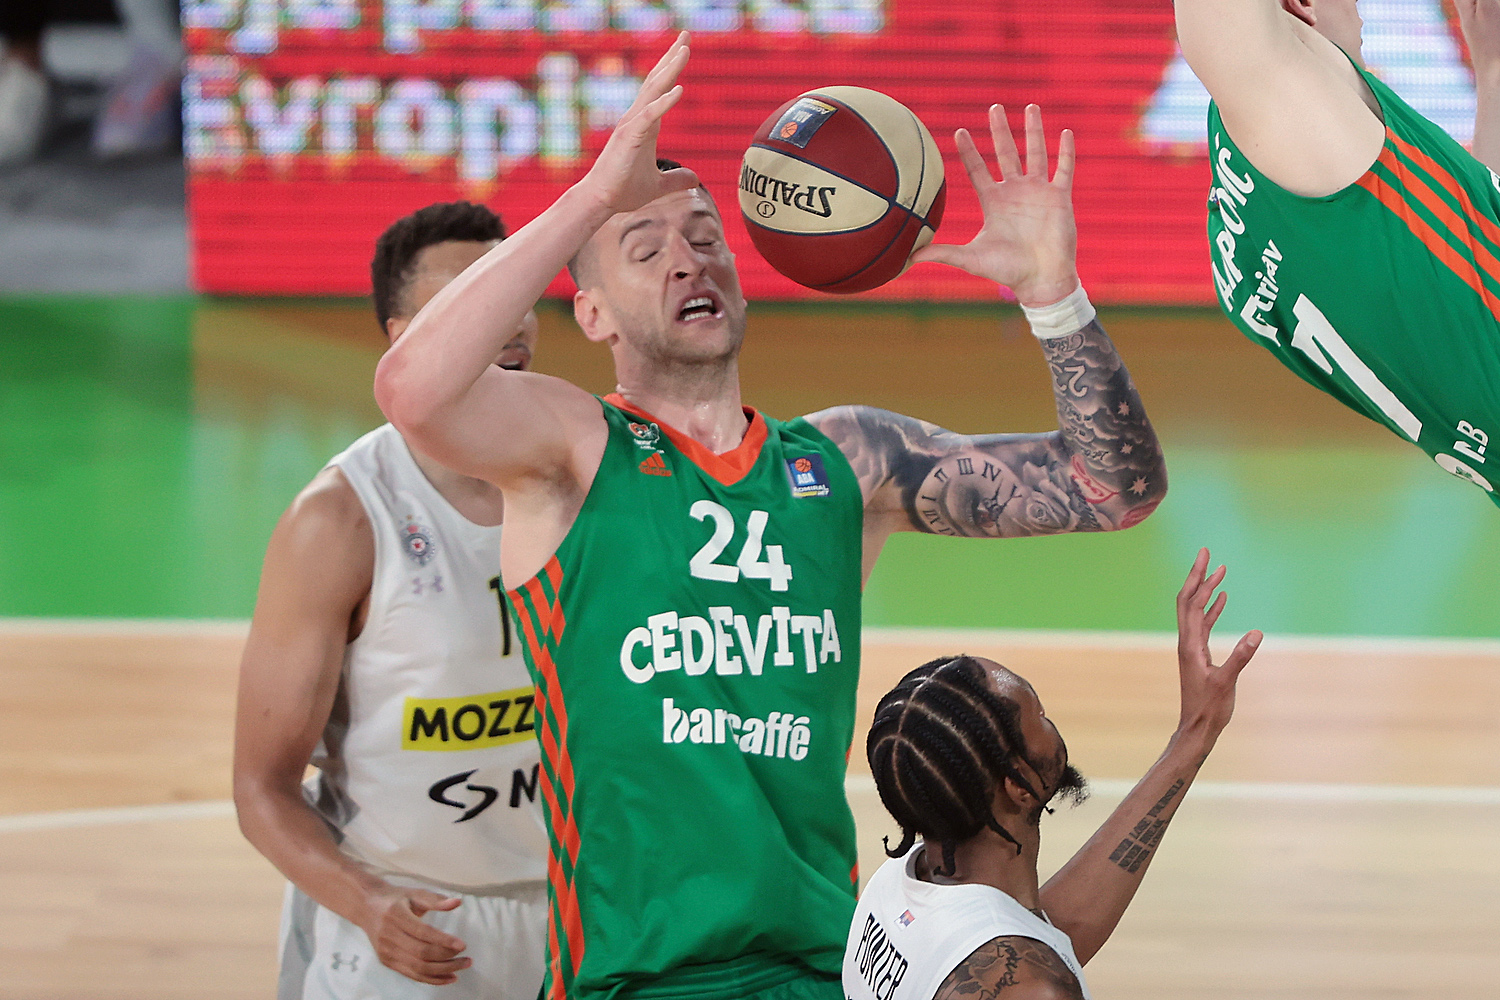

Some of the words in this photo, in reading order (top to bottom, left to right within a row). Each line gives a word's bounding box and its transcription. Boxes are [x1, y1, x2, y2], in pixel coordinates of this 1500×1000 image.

[1291, 292, 1423, 442] 7
[689, 499, 793, 592] 24
[619, 605, 842, 684] CEDEVITA
[409, 695, 535, 742] MOZZ
[662, 698, 811, 761] barcaffé
[854, 911, 909, 1000] PUNTER
